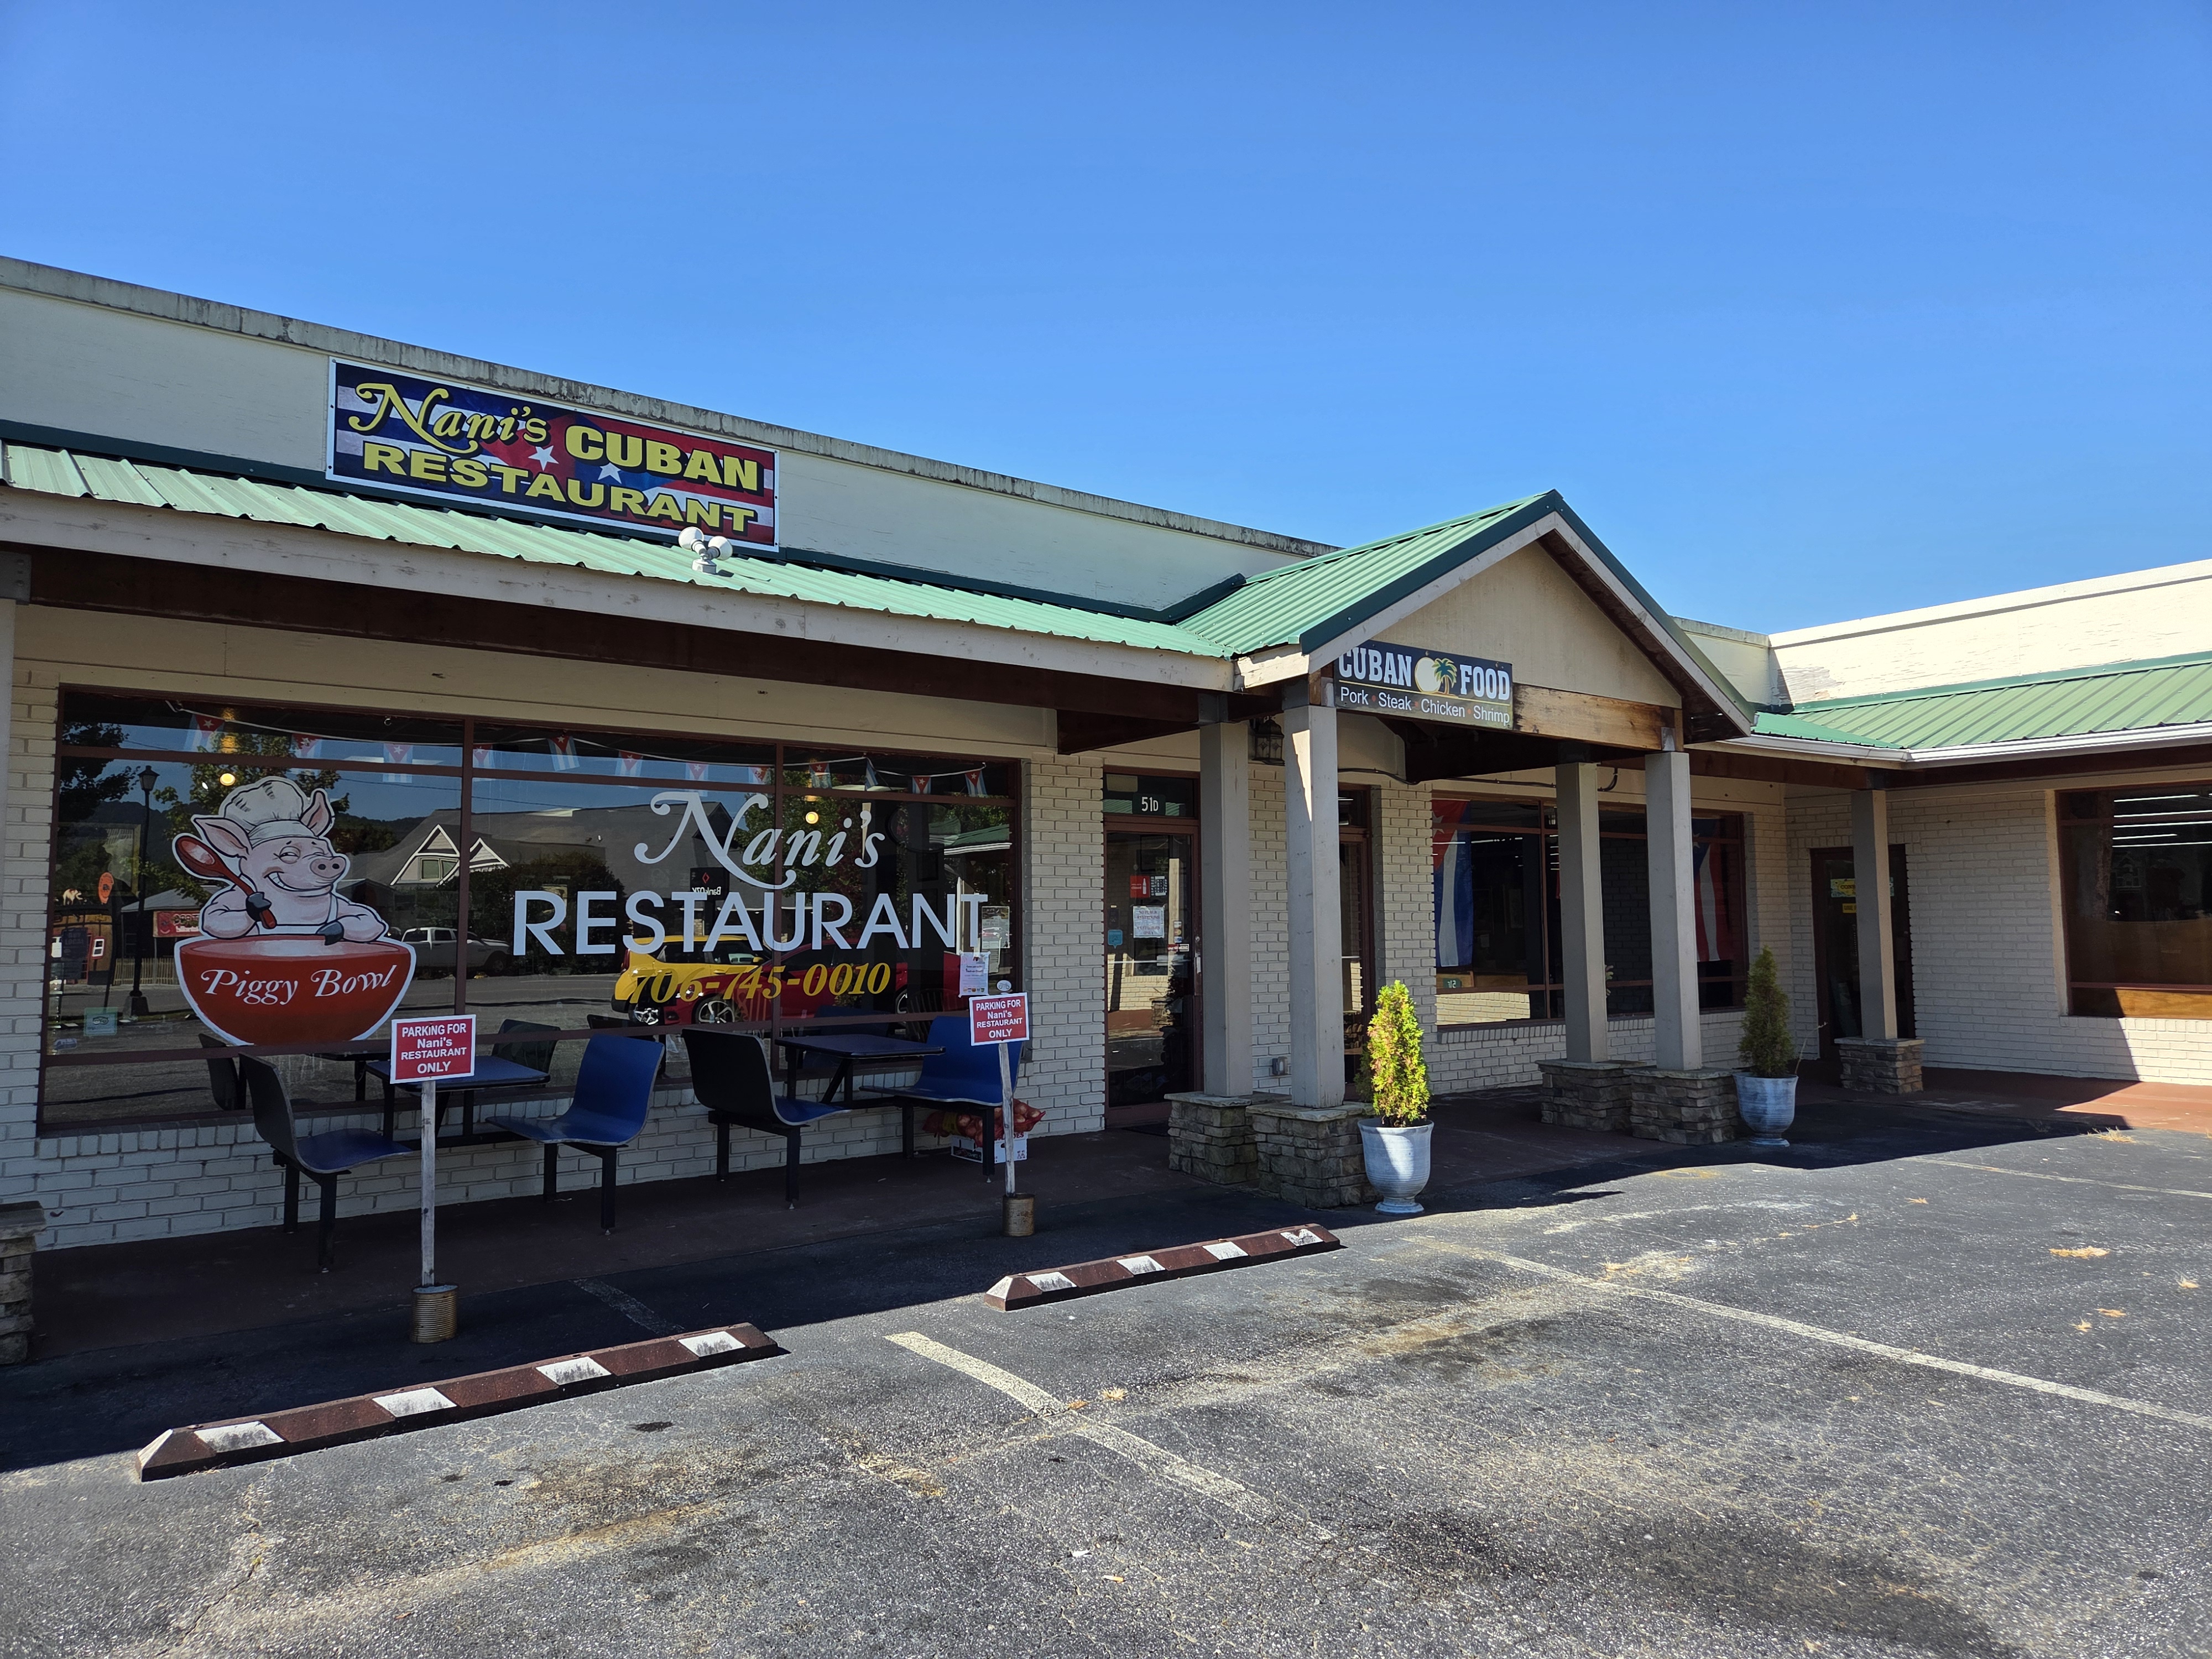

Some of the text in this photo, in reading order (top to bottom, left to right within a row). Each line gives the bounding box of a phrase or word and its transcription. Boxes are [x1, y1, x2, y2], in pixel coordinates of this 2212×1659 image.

[347, 382, 757, 490] Nani's CUBAN
[363, 442, 754, 532] RESTAURANT
[1339, 646, 1510, 701] CUBAN FOOD
[1340, 687, 1510, 726] Pork Steak Chicken Shrimp
[1141, 797, 1159, 812] 51D
[634, 791, 886, 890] Nani's
[513, 890, 988, 956] RESTAURANT
[200, 965, 397, 1006] Piggy Bowl
[629, 962, 891, 1005] 706-745-0010
[976, 999, 1021, 1011] PARKING FOR
[987, 1010, 1012, 1020] Nani's
[402, 1023, 466, 1037] PARKING FOR
[977, 1018, 1022, 1029] RESTAURANT
[989, 1029, 1012, 1038] ONLY
[417, 1037, 452, 1049] Nani's
[401, 1047, 467, 1061] RESTAURANT
[417, 1061, 451, 1073] ONLY
